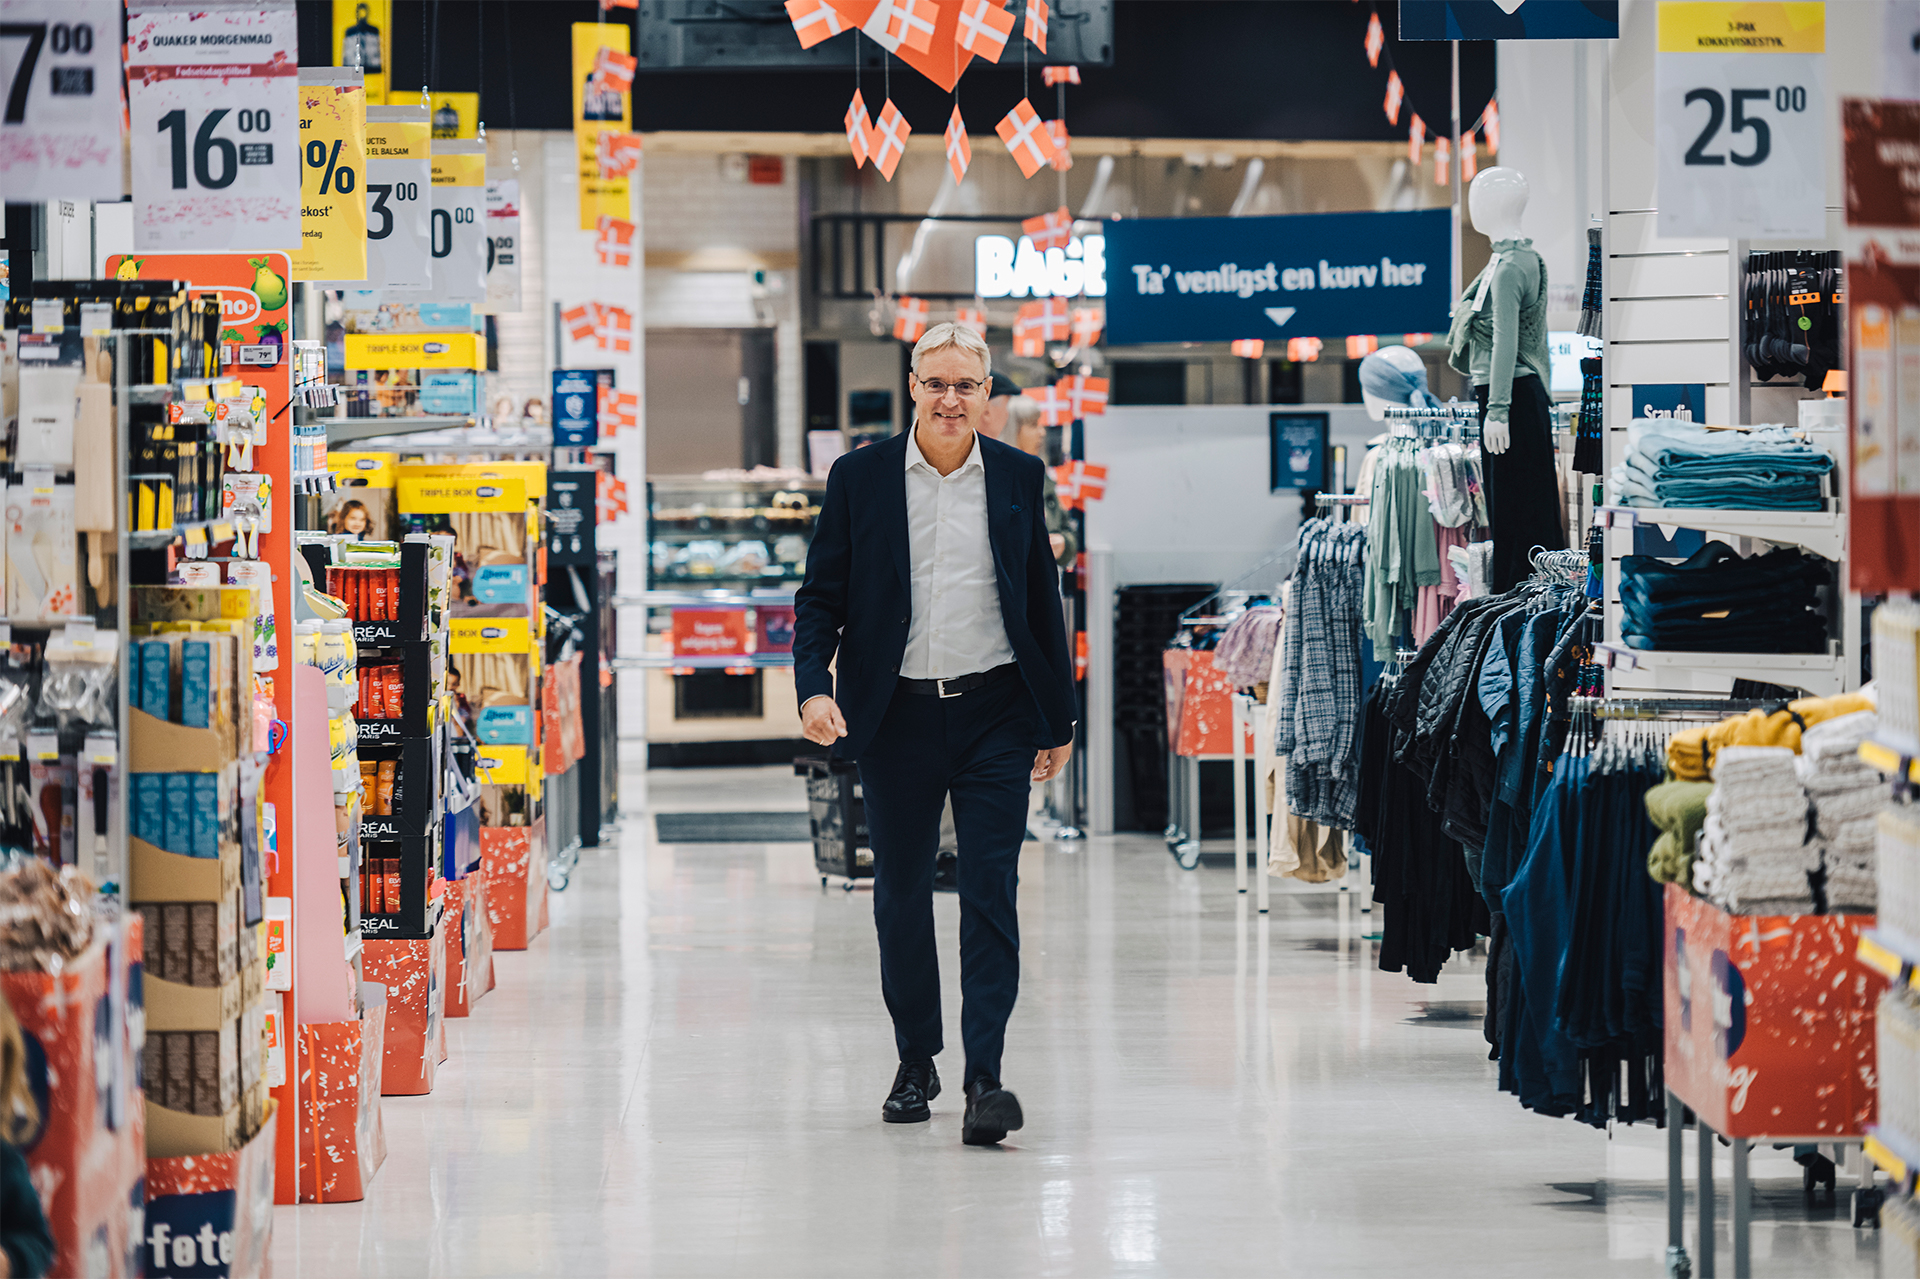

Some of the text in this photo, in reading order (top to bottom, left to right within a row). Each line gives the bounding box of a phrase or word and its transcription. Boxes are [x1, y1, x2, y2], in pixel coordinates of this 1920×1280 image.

[1727, 22, 1756, 32] 3-PAK
[52, 23, 93, 54] 00
[153, 34, 272, 46] QUAKER MORGENMAD
[175, 66, 251, 77] Fødselsdagstilbud
[1684, 86, 1807, 167] 25 00
[157, 108, 271, 190] 16 00
[366, 182, 418, 240] 3 00
[455, 207, 474, 224] 00
[301, 229, 323, 239] redag
[1132, 257, 1426, 298] Ta' venligst en kurv her
[366, 344, 419, 353] TRIPLE BOX
[420, 488, 473, 498] TRIPLE BOX
[354, 626, 396, 638] RÉAL
[360, 917, 399, 929] RÉAL
